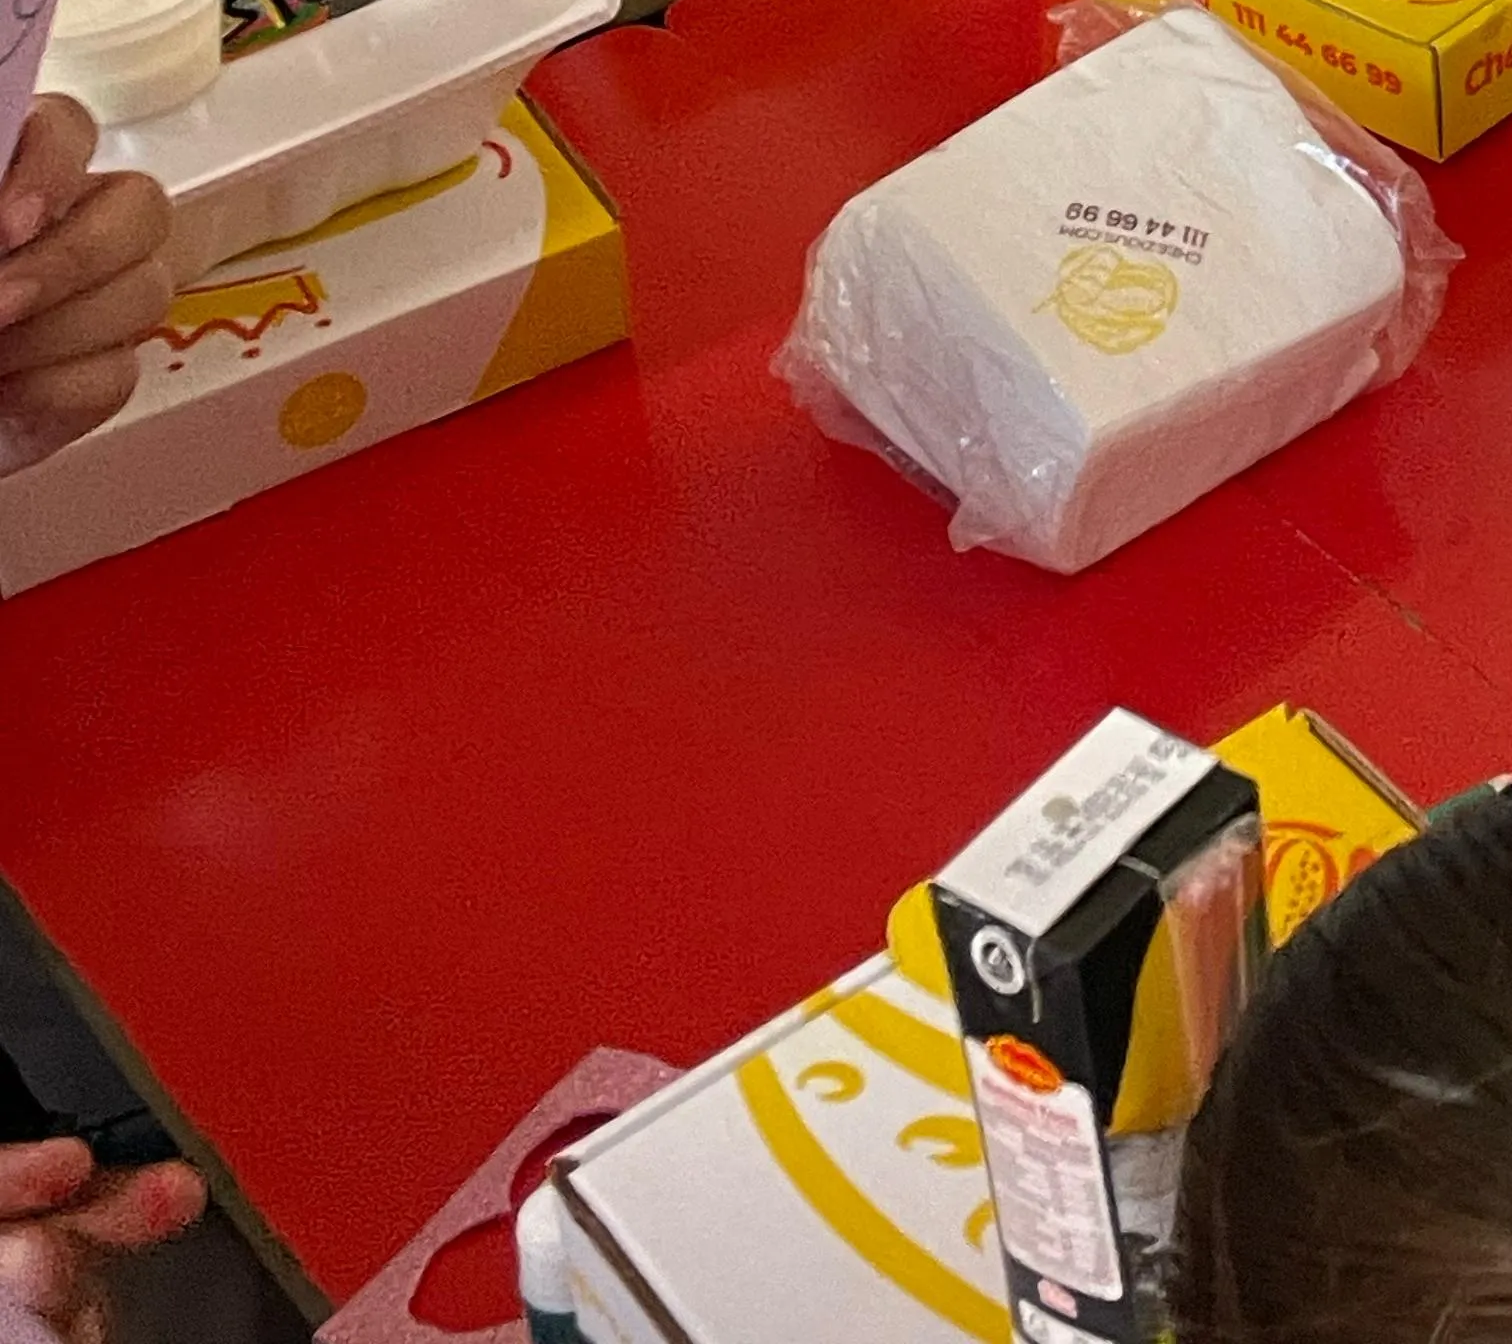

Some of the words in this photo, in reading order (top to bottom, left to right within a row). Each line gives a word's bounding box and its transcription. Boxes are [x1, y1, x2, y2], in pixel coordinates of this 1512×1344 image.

[1232, 1, 1266, 36] 111
[1276, 24, 1313, 55] 44
[1321, 44, 1357, 76] 66
[1365, 63, 1402, 95] 99
[1065, 202, 1100, 222] 99
[1106, 209, 1138, 231] 66
[1145, 218, 1176, 238] 44
[1182, 226, 1209, 248] 111
